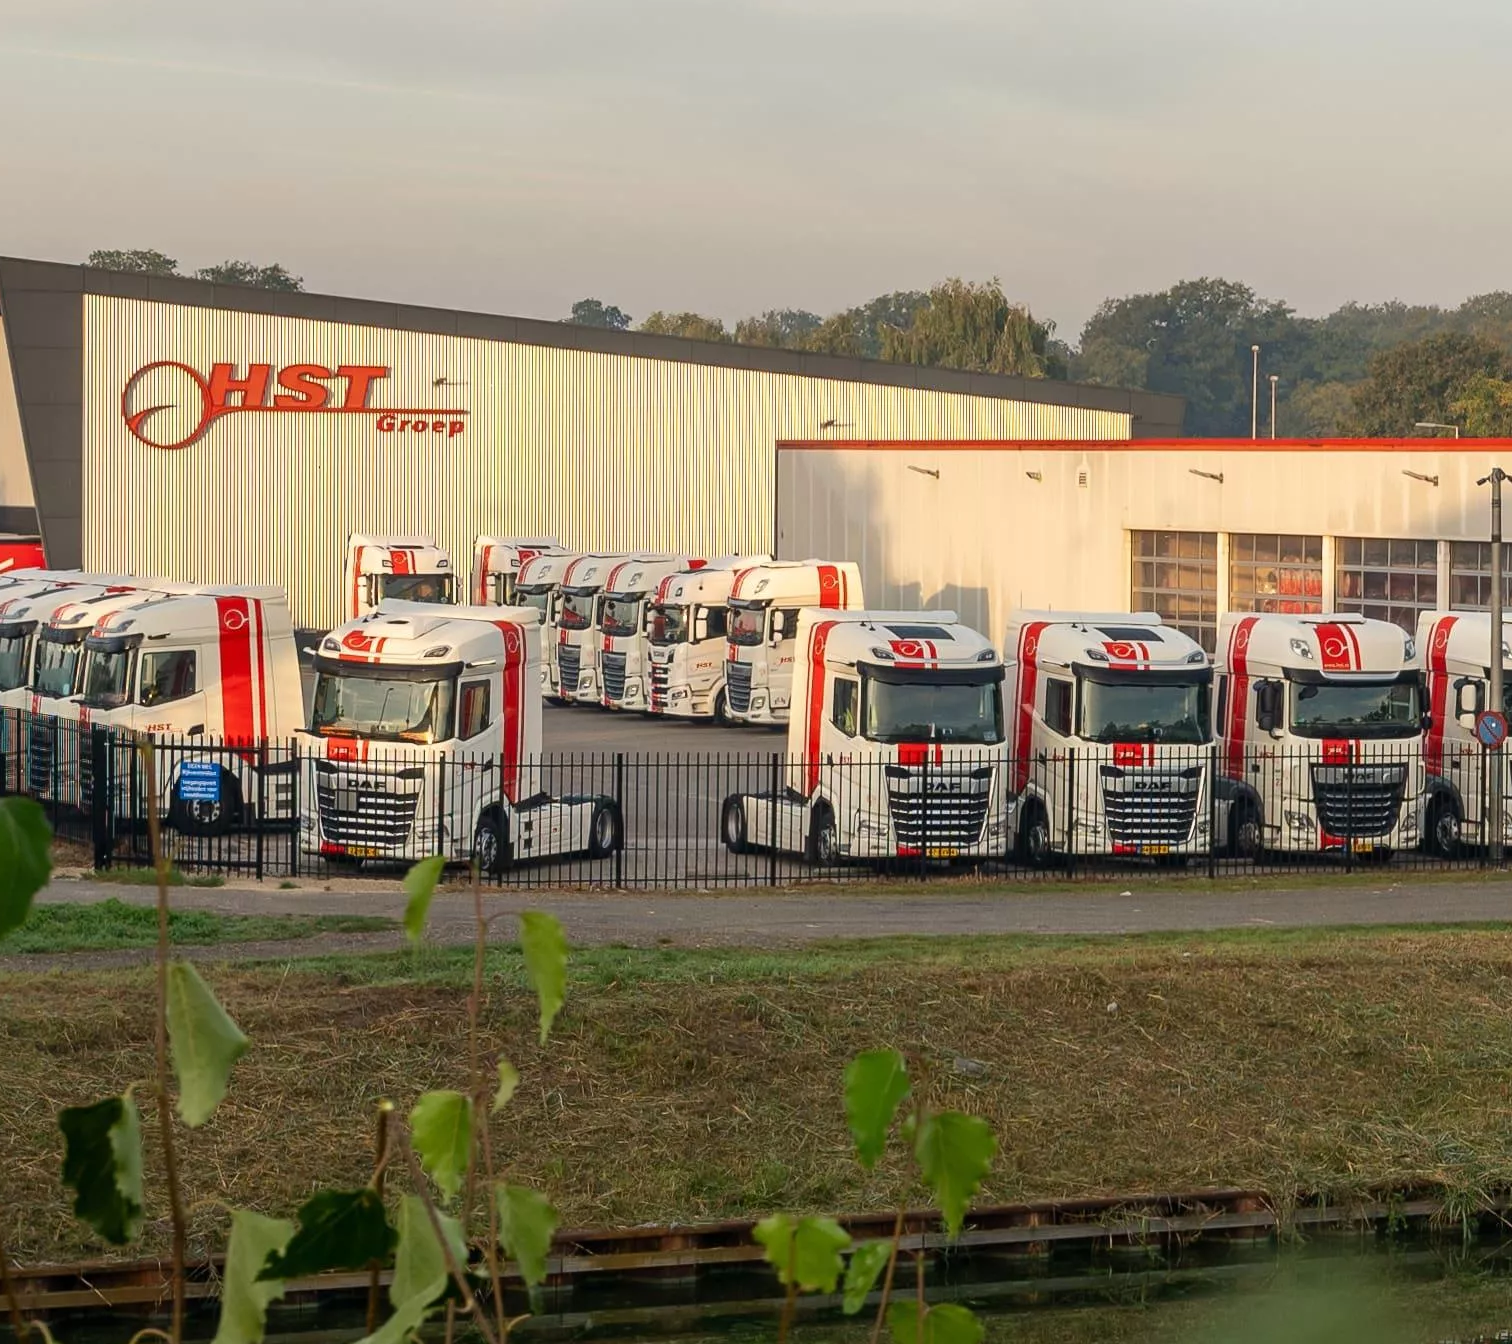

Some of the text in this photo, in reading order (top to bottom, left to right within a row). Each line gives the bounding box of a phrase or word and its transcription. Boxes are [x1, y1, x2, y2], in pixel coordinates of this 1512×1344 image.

[207, 362, 388, 409] HST
[375, 413, 465, 438] Groep
[147, 723, 173, 732] HST
[347, 779, 387, 790] DAF
[1135, 781, 1172, 790] DAF
